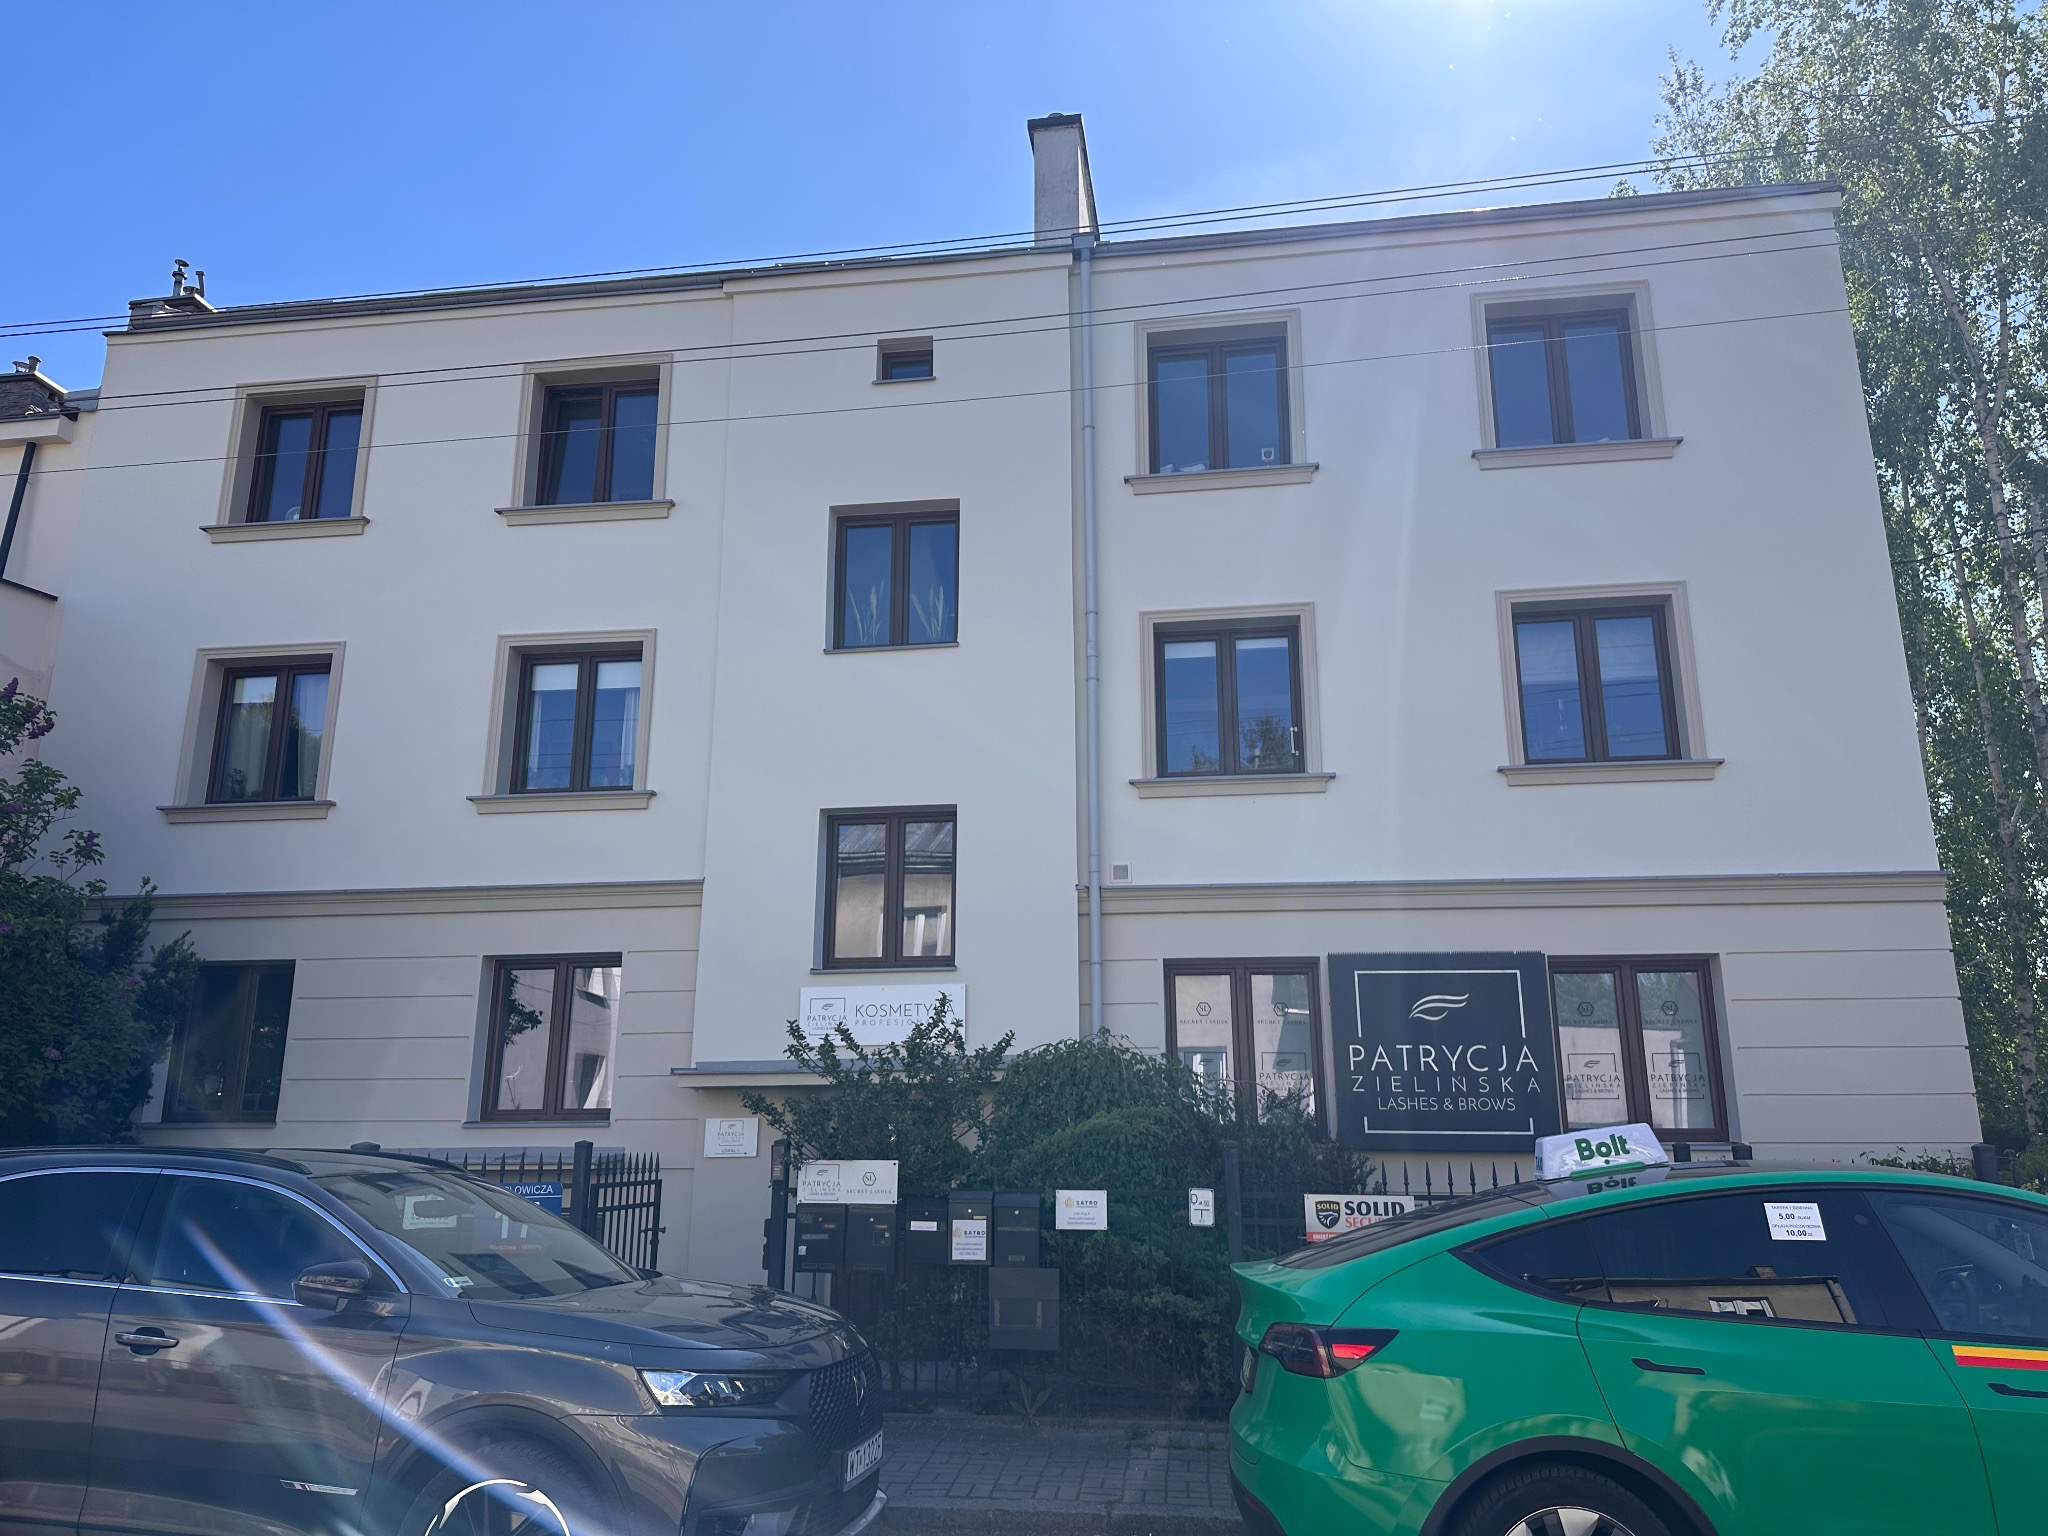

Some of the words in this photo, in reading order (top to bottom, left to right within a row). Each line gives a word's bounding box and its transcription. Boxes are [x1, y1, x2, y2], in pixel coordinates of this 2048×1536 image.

[855, 1003, 955, 1018] KOSMETYA
[807, 1014, 848, 1022] PATRYCJA
[1348, 1044, 1540, 1073] PATRYCJA
[1259, 1072, 1310, 1081] PATRYCJA
[1566, 1074, 1620, 1082] PATRYCJA
[1650, 1074, 1706, 1082] PATRYCJA
[1378, 1097, 1438, 1110] LASHES
[1443, 1098, 1454, 1110] &
[1459, 1098, 1516, 1110] BROWS
[1574, 1133, 1631, 1161] Bolt
[1317, 1202, 1339, 1210] SOLID
[1344, 1201, 1405, 1217] SOLID
